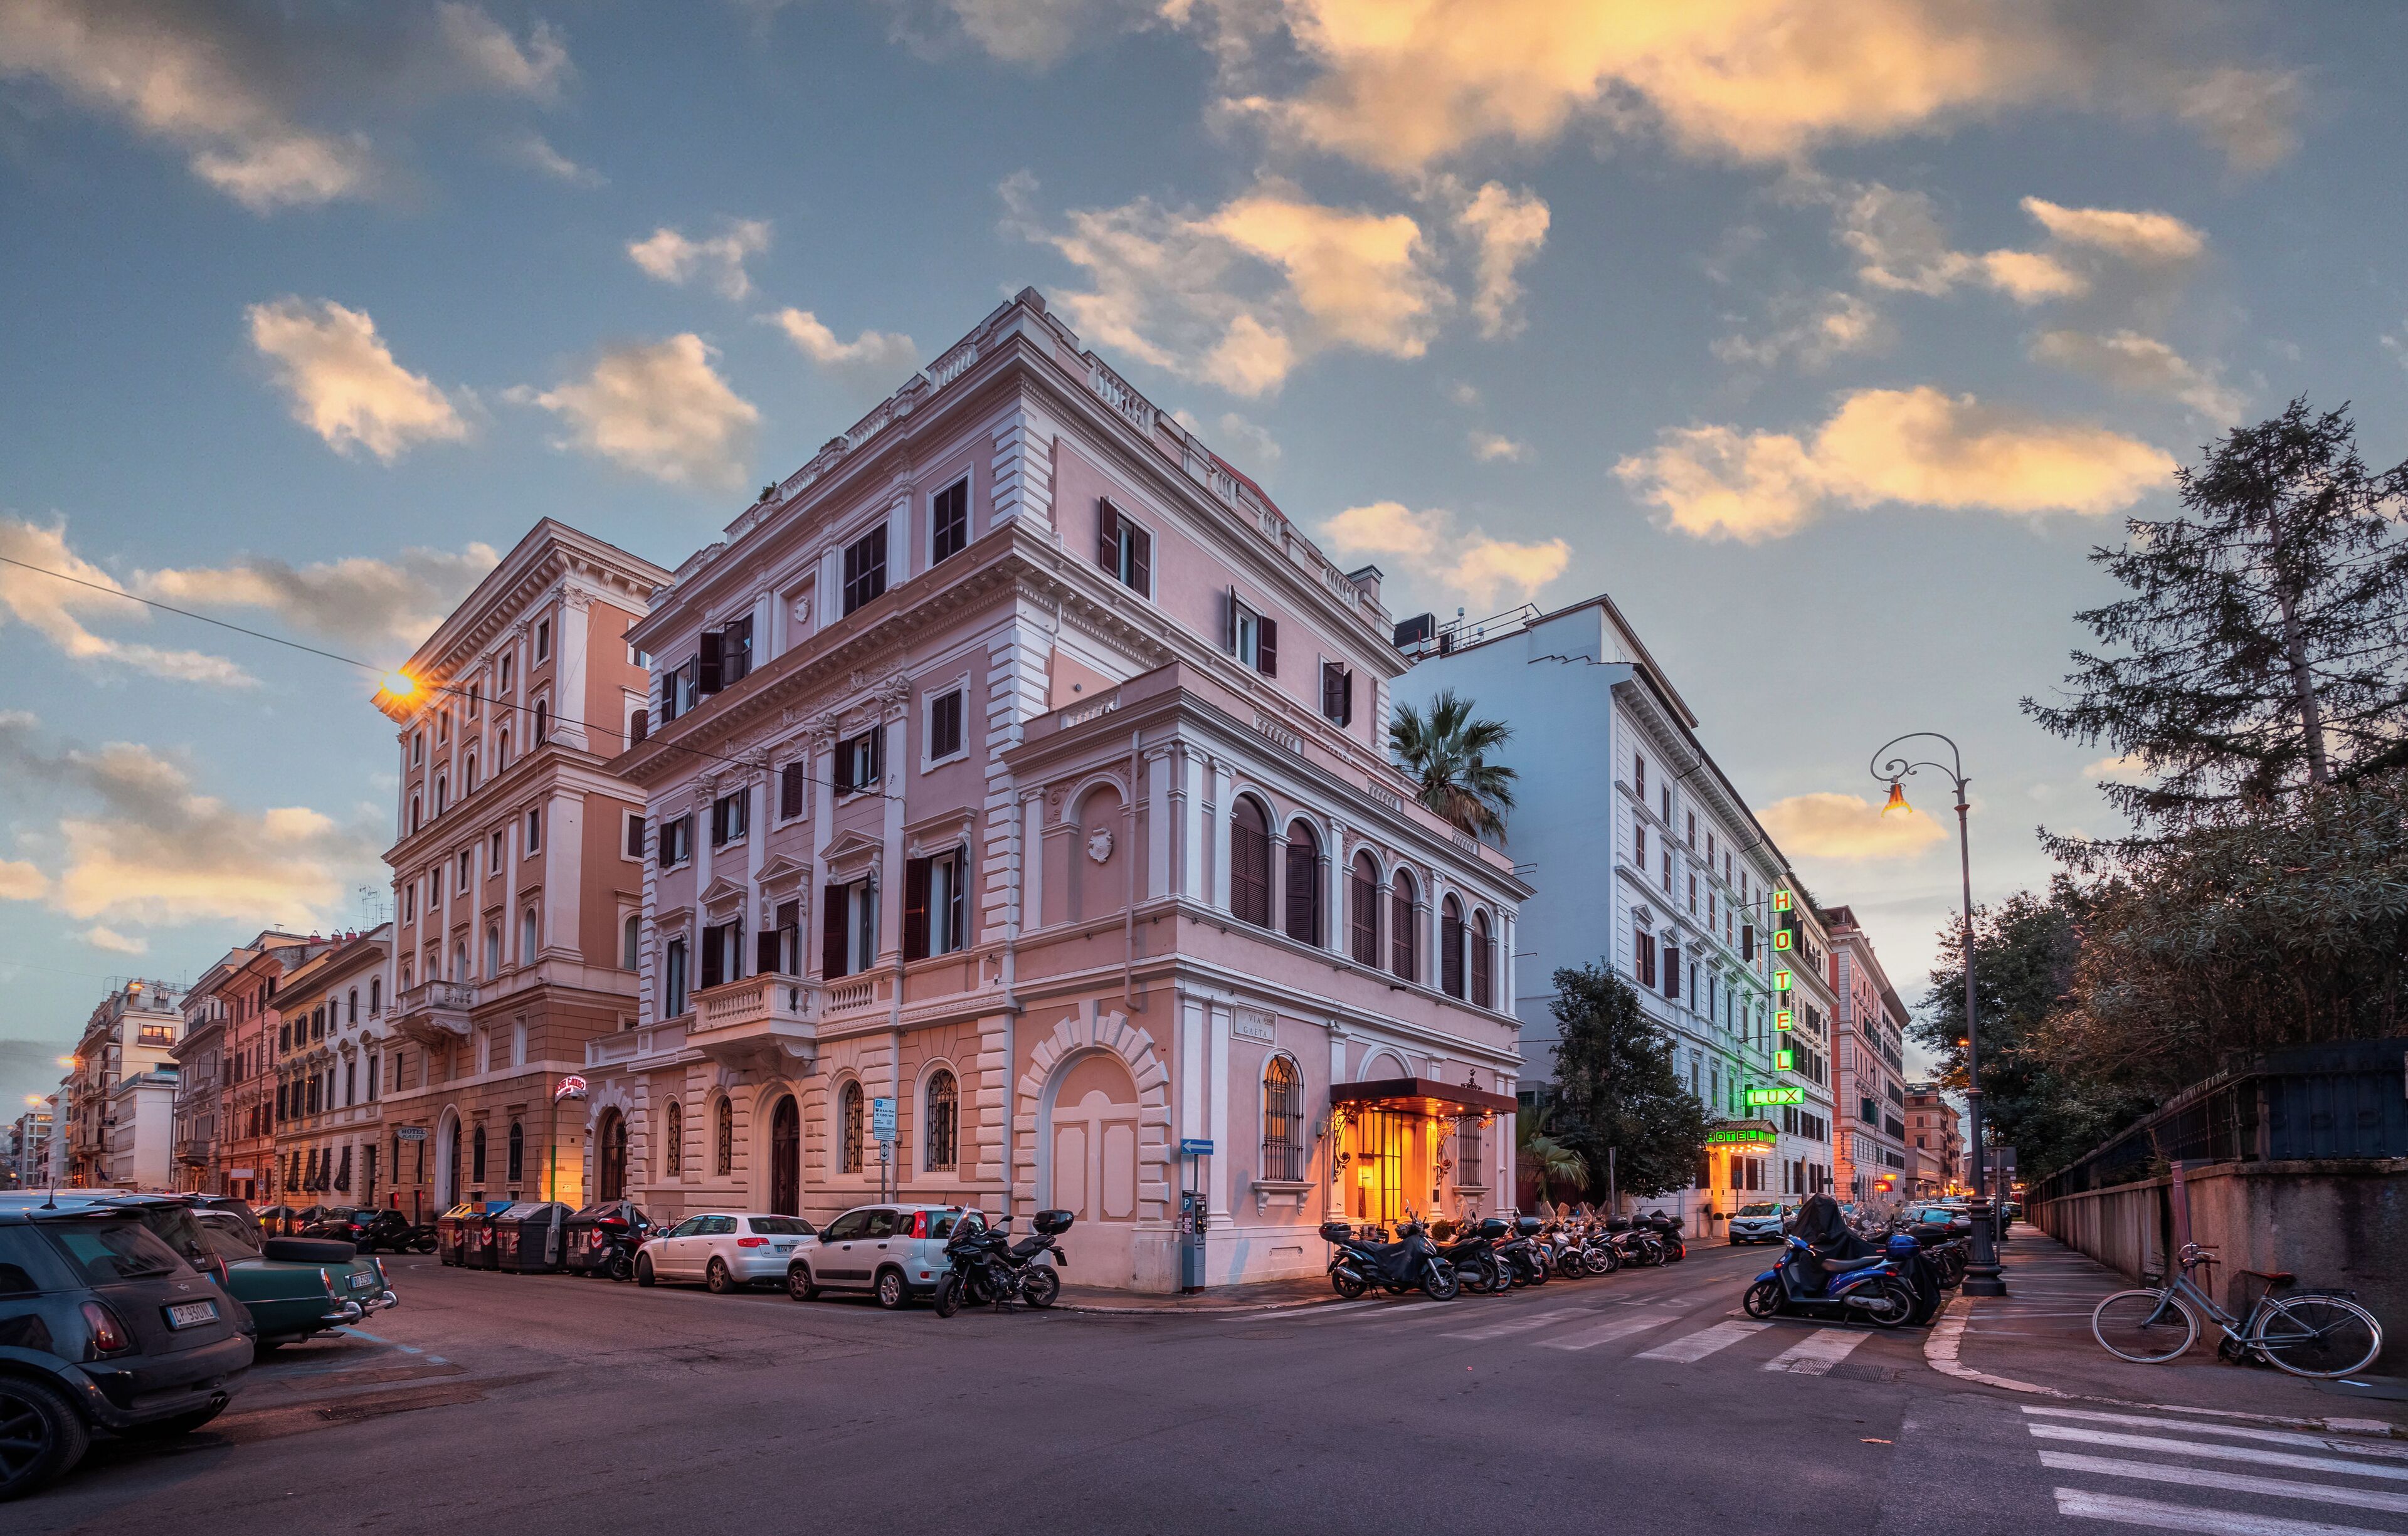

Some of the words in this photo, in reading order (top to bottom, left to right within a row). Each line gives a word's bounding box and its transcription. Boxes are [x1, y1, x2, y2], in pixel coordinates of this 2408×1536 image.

[1775, 892, 1789, 1069] HOTEL
[1249, 1014, 1261, 1024] VIA
[1243, 1026, 1267, 1038] GAETA
[1753, 1089, 1798, 1104] LUX
[1707, 1132, 1756, 1142] HOTEL
[173, 1308, 185, 1323] CP
[186, 1303, 214, 1321] 930NL
